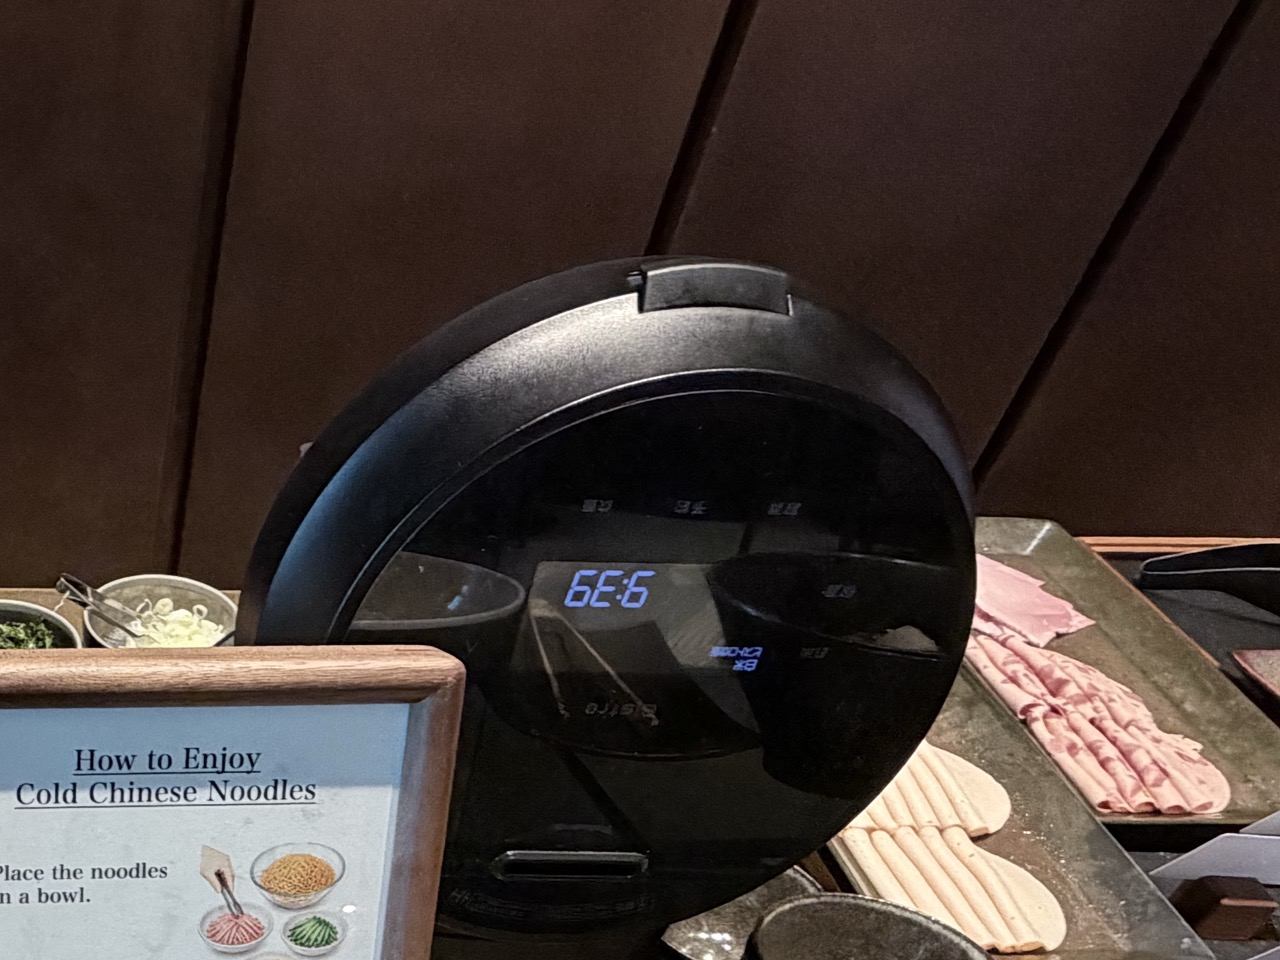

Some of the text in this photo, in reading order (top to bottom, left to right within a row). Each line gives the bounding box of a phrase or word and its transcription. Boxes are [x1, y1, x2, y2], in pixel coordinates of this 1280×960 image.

[73, 747, 262, 775] How to Enjoy
[16, 779, 317, 805] Cold Chinese Noodles
[52, 864, 84, 880] the
[91, 862, 168, 880] noodles
[18, 891, 30, 904] a
[37, 887, 91, 904] bowl.
